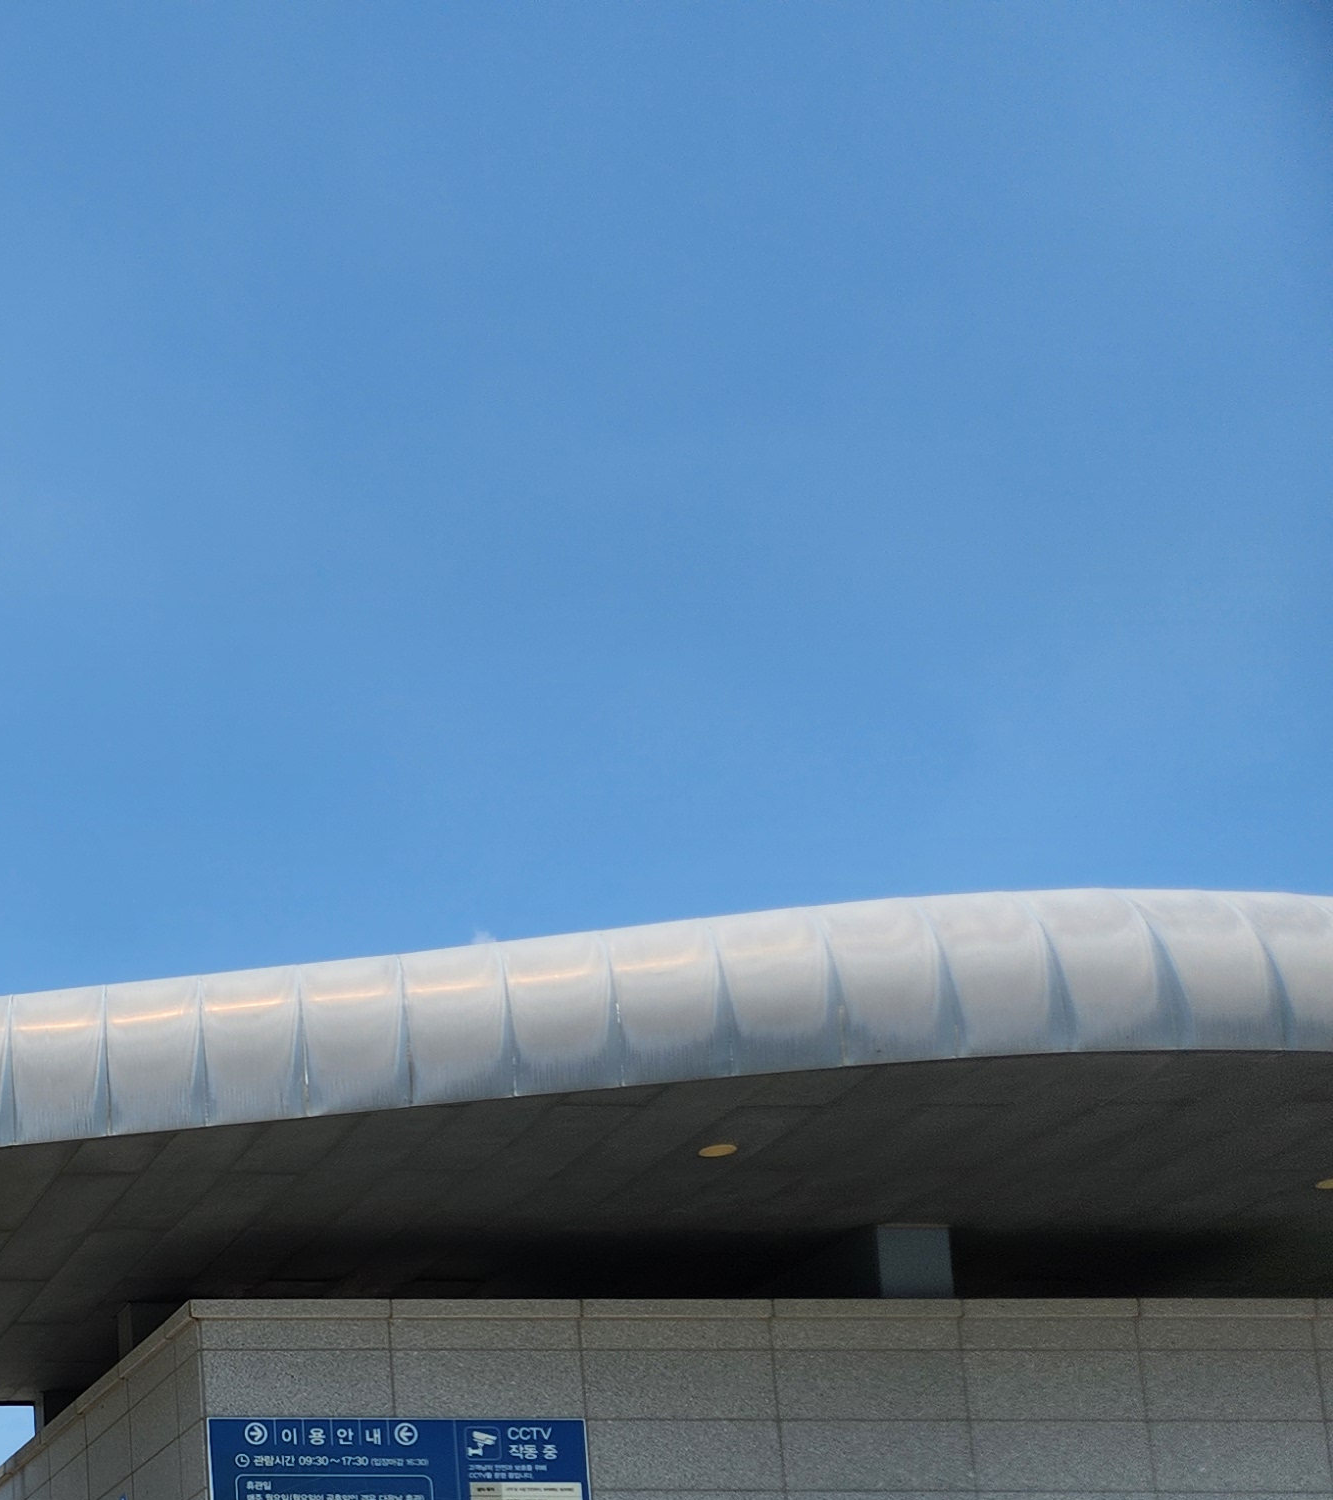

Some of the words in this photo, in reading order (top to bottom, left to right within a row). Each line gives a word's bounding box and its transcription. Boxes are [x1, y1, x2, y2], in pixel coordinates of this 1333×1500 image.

[507, 1426, 552, 1440] CCTV
[508, 1444, 539, 1460] 작동
[542, 1444, 558, 1460] 중
[253, 1455, 295, 1467] 관람시간
[245, 1480, 272, 1491] 휴관일
